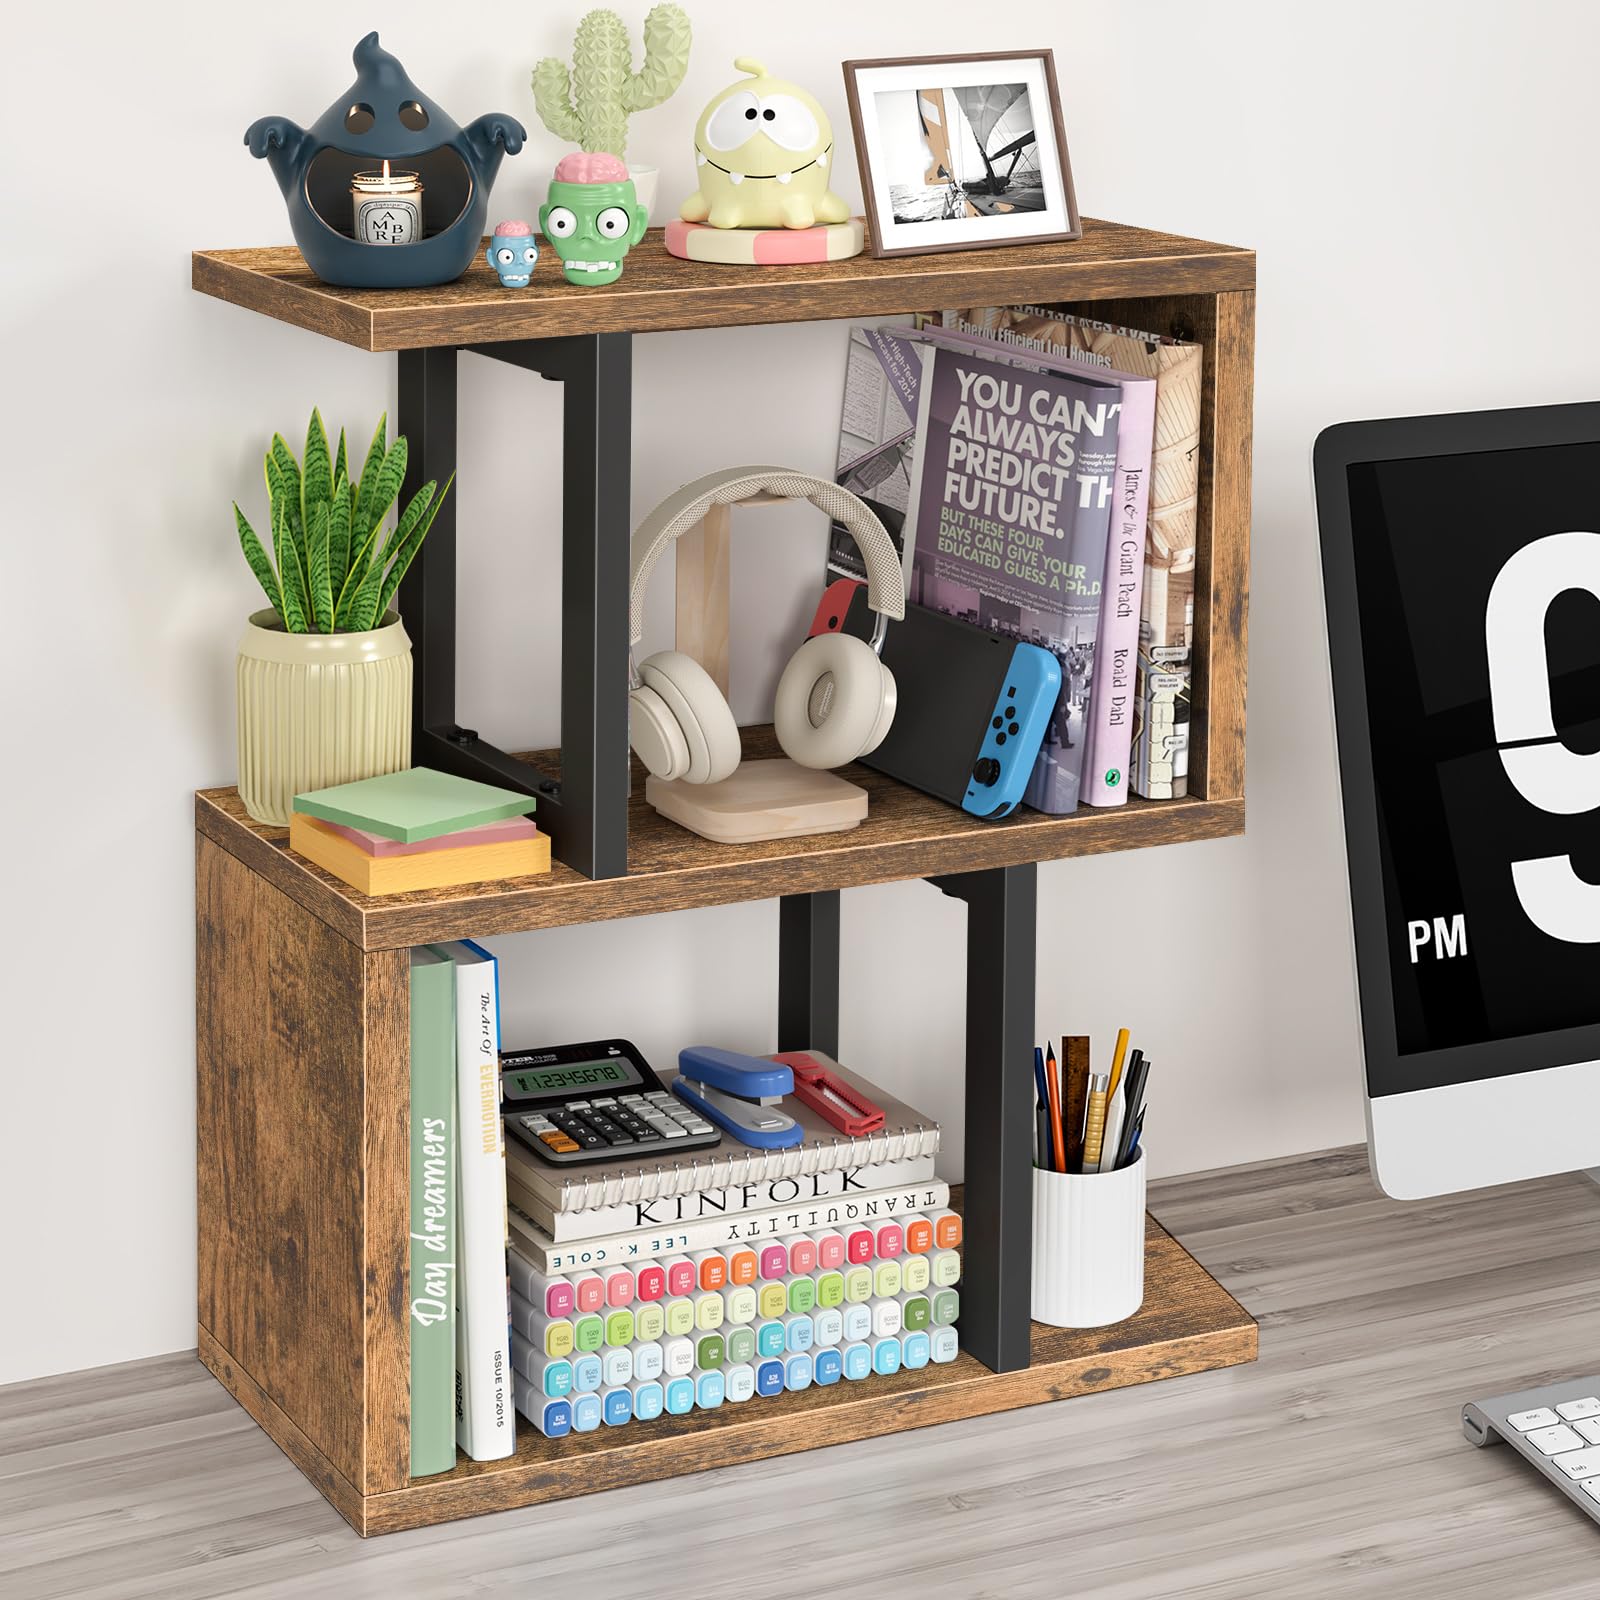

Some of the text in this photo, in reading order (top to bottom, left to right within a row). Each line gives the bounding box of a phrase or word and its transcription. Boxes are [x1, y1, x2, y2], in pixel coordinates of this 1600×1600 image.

[891, 341, 917, 388] High-Tech
[998, 327, 1045, 353] Efficient
[1070, 345, 1111, 368] Homes
[890, 364, 900, 377] for
[898, 377, 914, 402] 2014
[956, 368, 1022, 415] YOU
[950, 405, 1075, 467] ALWAYS
[948, 437, 1069, 501] PREDICT
[1120, 465, 1142, 502] James
[944, 471, 1064, 539] FUTURE.
[940, 522, 1086, 579] DAYS CAN GIVE YOUR
[941, 506, 1044, 552] BUT THESE FOUR
[1123, 522, 1136, 536] the
[938, 537, 1000, 570] EDUCATED
[1005, 560, 1046, 586] GUESS
[1050, 576, 1060, 592] A
[1120, 541, 1138, 576] Giant
[1117, 582, 1136, 618] Peach
[1113, 649, 1128, 688] Roald
[1110, 696, 1126, 726] Dahl
[1408, 914, 1467, 963] PM
[480, 992, 496, 1154] The Art Of EVERMOTION
[533, 1066, 620, 1088] 1.2345678
[635, 1166, 868, 1226] KINFOLK
[727, 1191, 936, 1240] TRANQUILITY
[410, 1118, 455, 1327] Day dreamers
[652, 1235, 687, 1251] LEE
[553, 1250, 606, 1268] COLE
[494, 1350, 502, 1384] ISSUE
